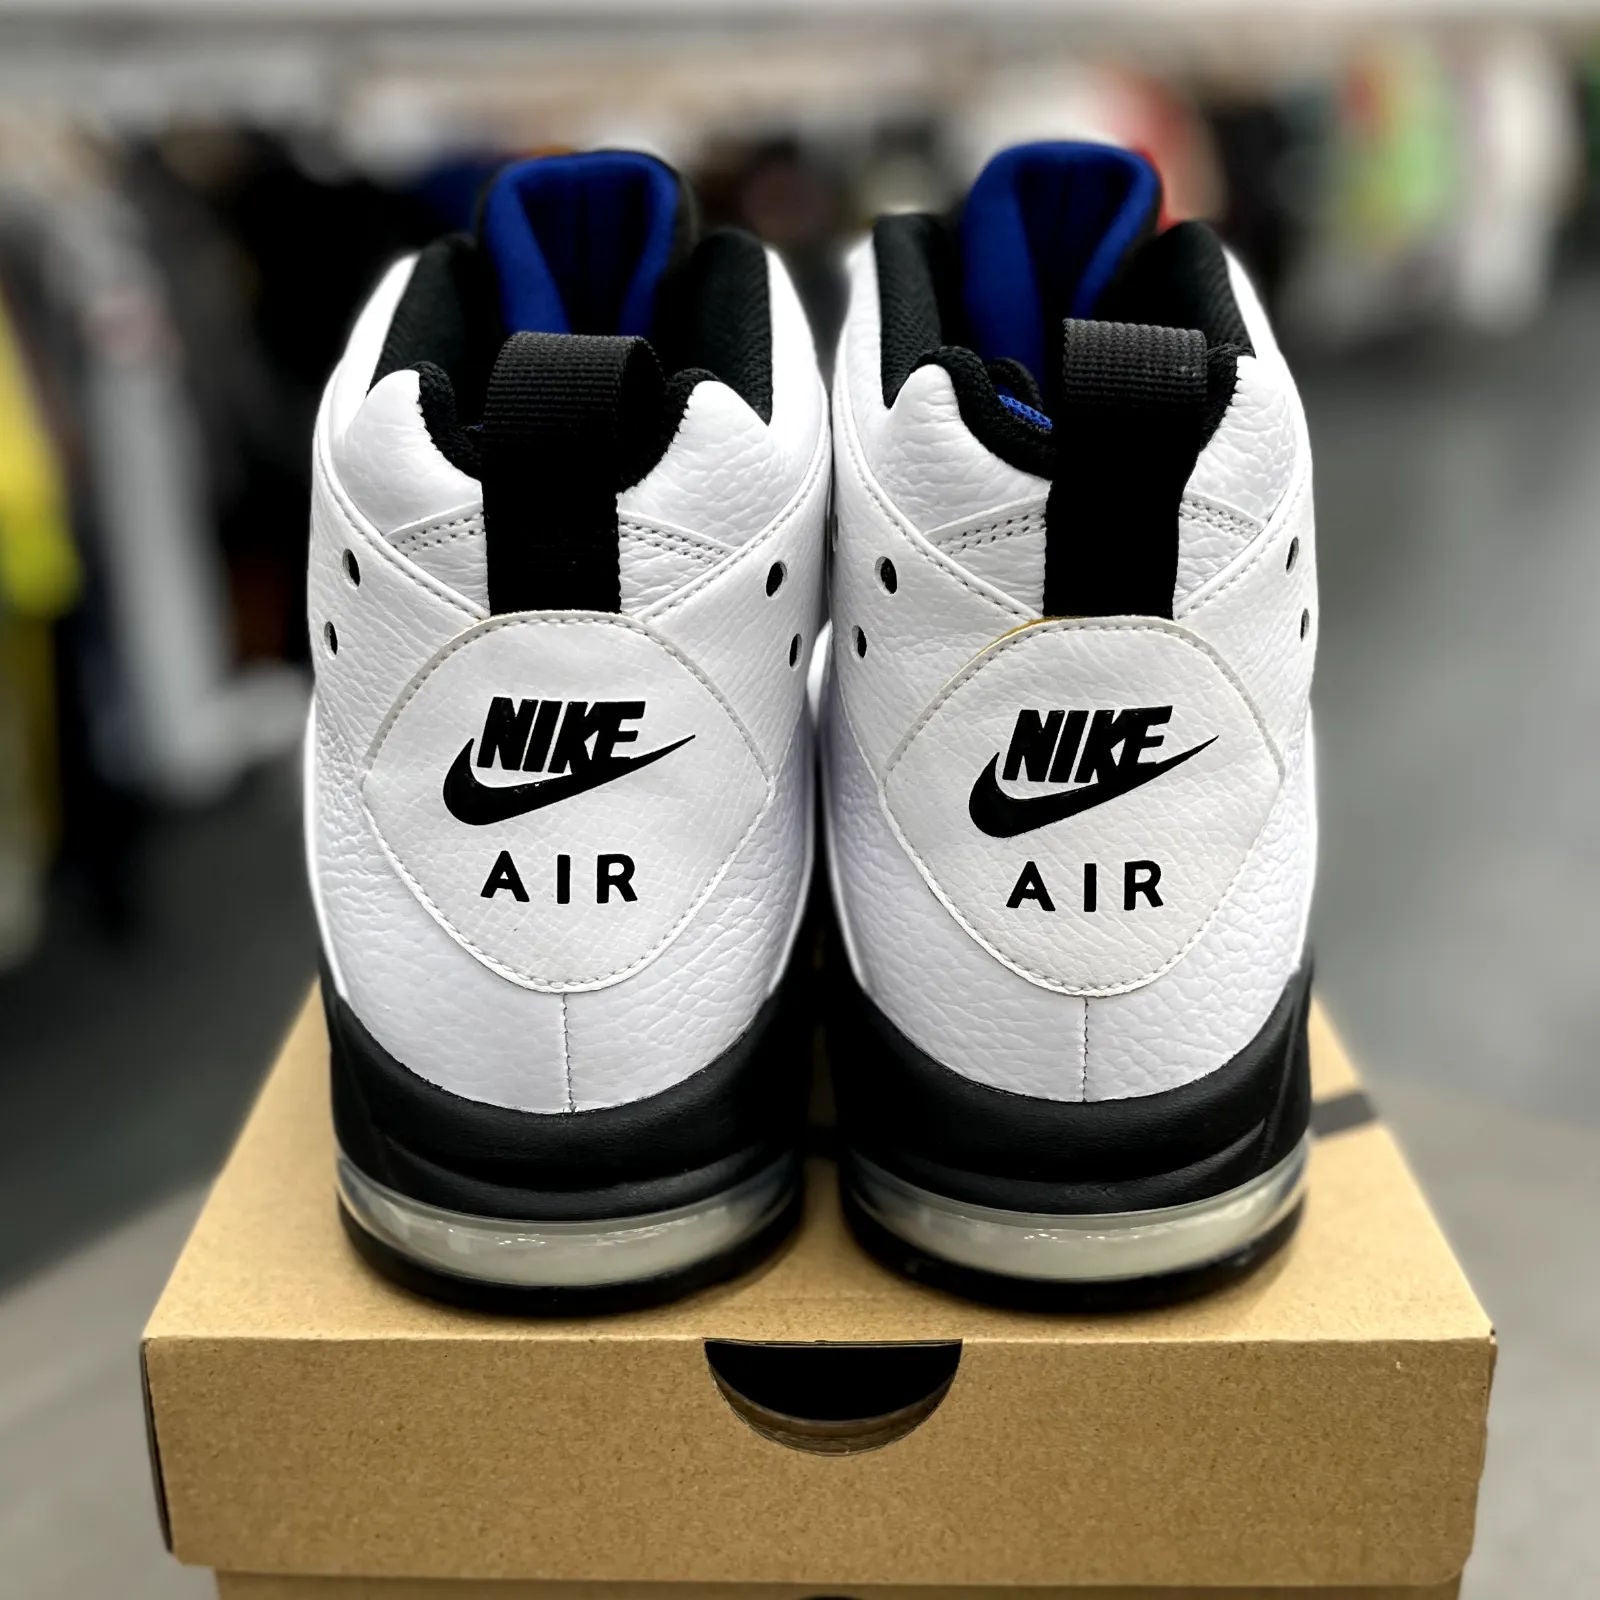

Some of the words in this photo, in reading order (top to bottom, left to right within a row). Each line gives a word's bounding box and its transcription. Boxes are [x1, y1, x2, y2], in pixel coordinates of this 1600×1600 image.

[476, 696, 646, 775] NIKE
[1002, 705, 1173, 784] NIKE
[480, 850, 638, 904] AIR
[1005, 860, 1164, 913] AIR
